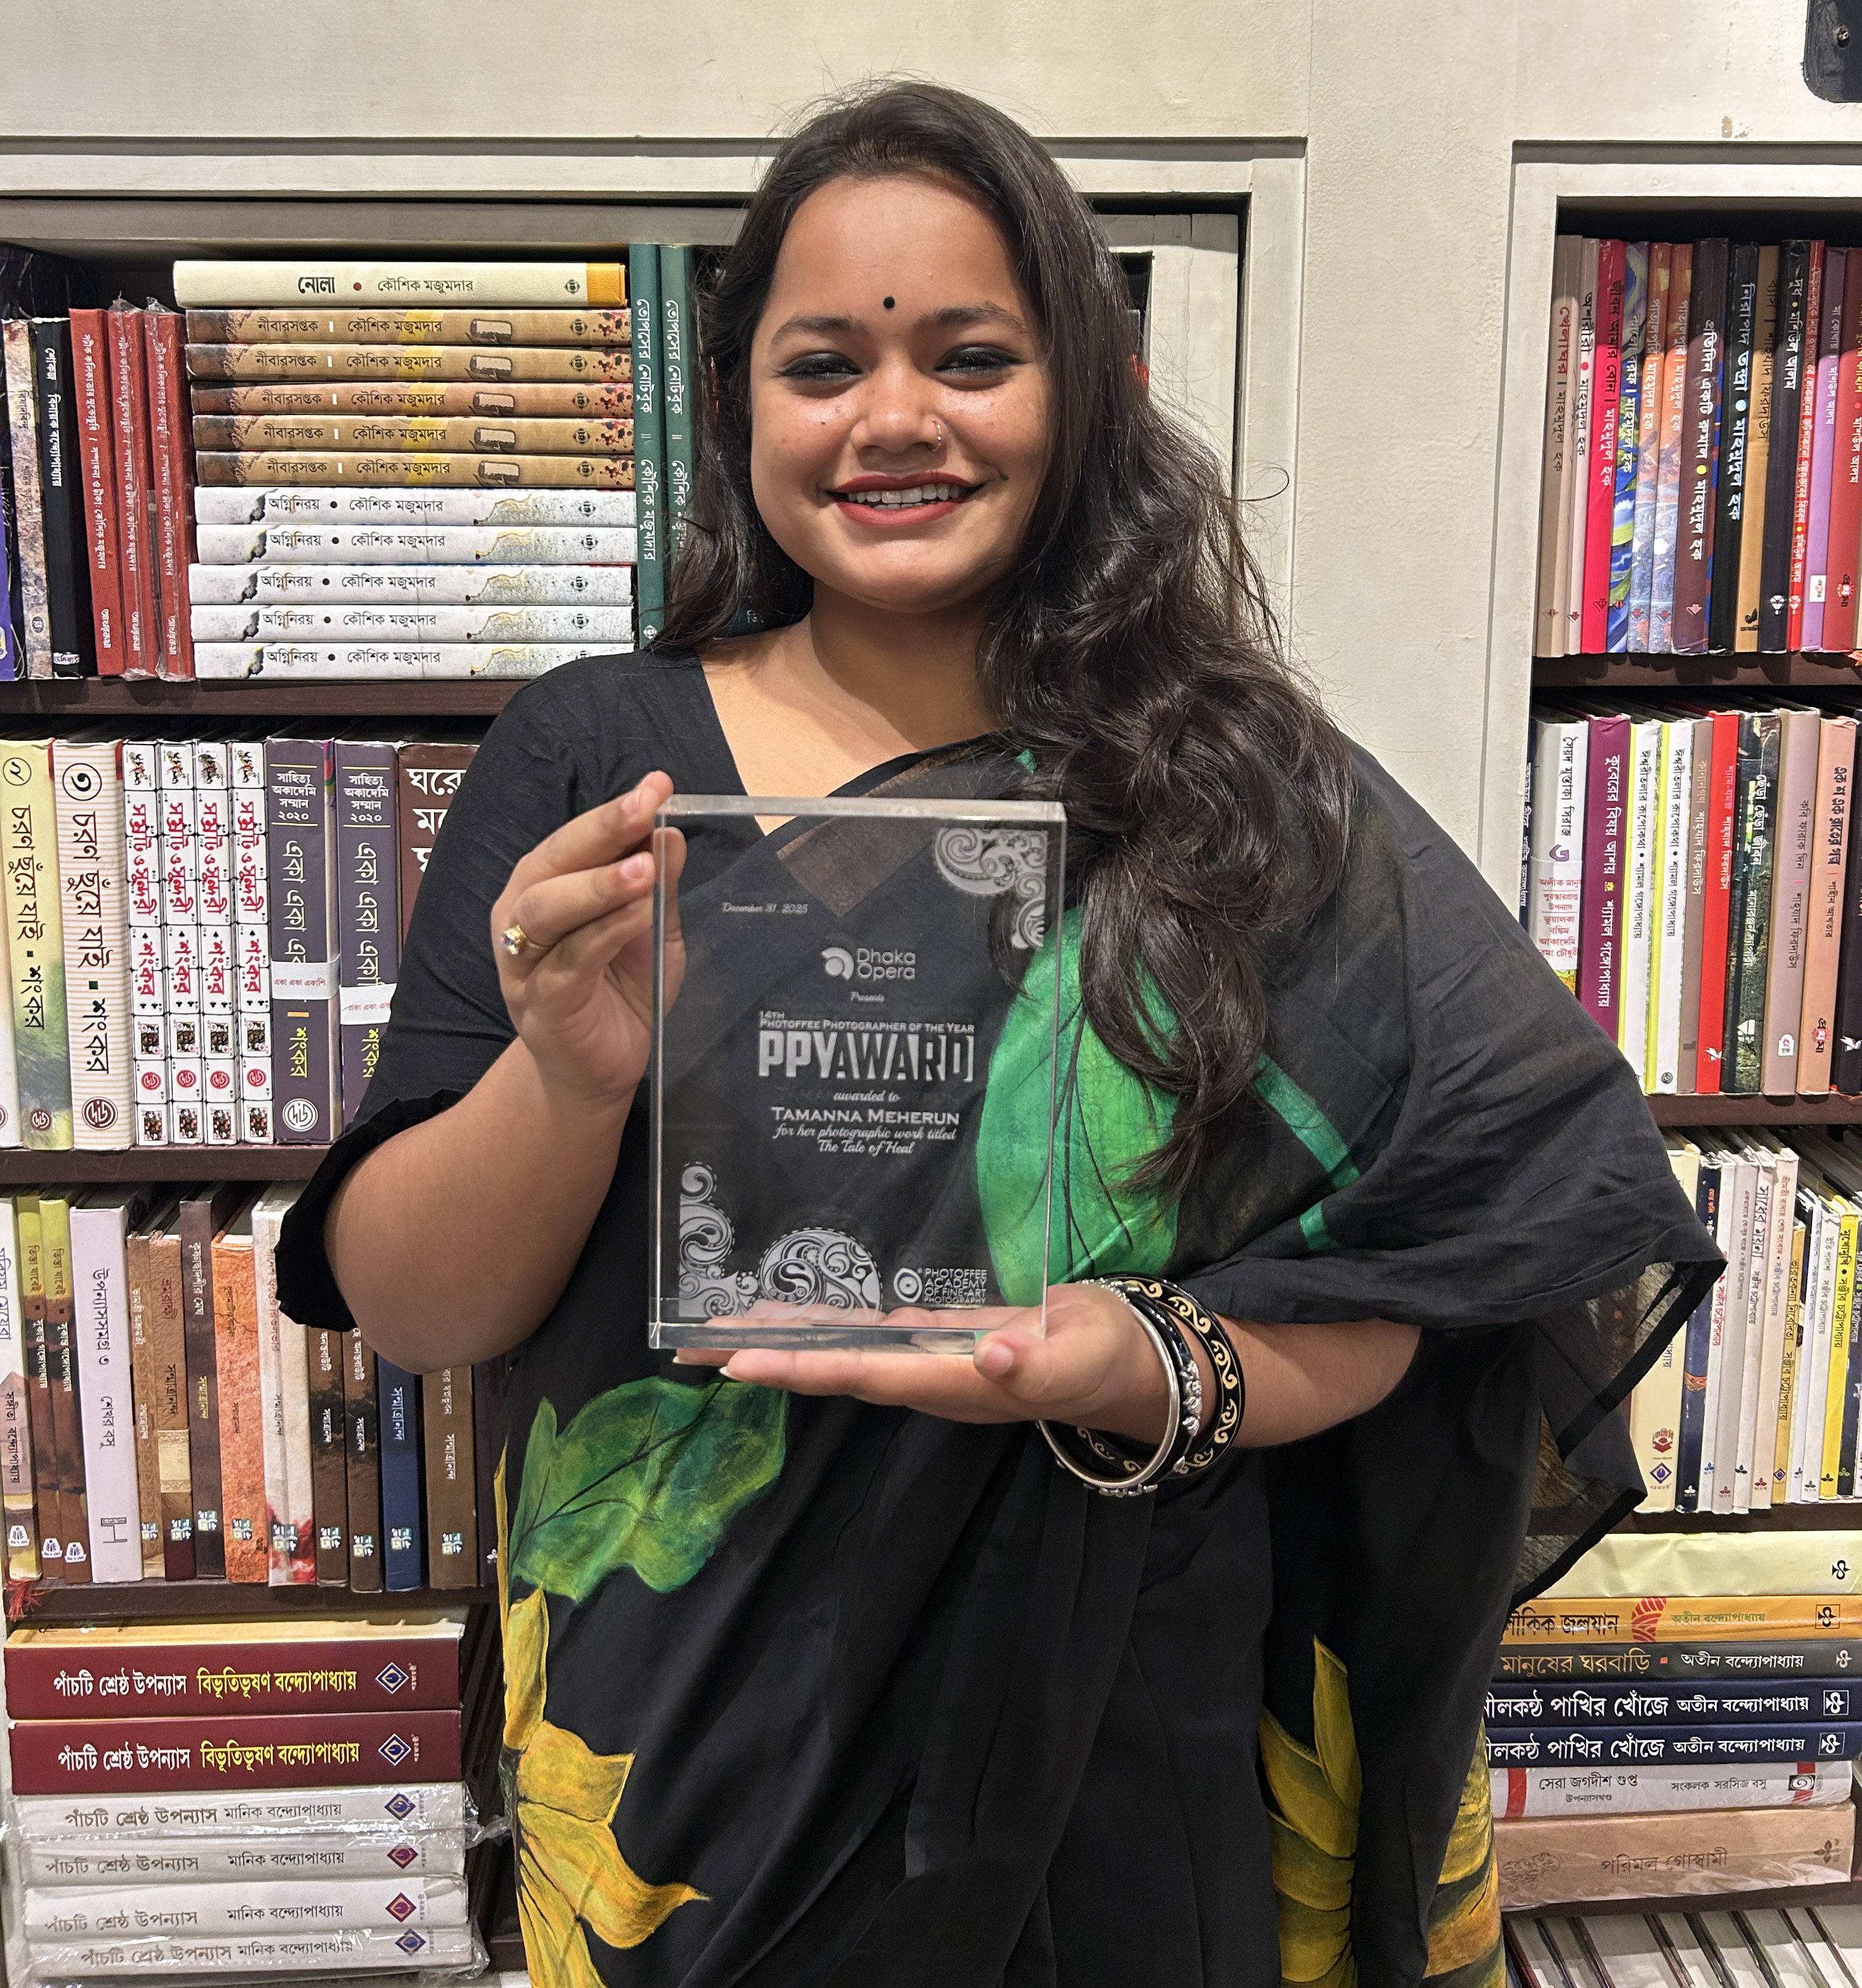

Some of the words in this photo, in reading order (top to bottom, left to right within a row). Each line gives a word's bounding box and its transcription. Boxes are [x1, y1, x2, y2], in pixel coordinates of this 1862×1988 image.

[298, 277, 335, 294] নোলা
[378, 278, 420, 293] কৌশিক
[424, 280, 473, 294] মজুমদার
[1789, 279, 1804, 297] দুধ
[258, 320, 318, 334] নীবারসপ্তক
[348, 318, 390, 333] কৌশিক
[394, 320, 442, 334] মজুমদার
[637, 299, 651, 359] তোপসের
[1738, 283, 1754, 344] নিরাপদ
[1557, 305, 1570, 374] খেলাঘর
[1700, 320, 1715, 372] প্রতিদিন
[1786, 311, 1800, 351] মশিউল
[1732, 351, 1751, 391] তন্দ্রা
[1784, 357, 1798, 389] আলম
[262, 392, 321, 406] নীবারসপ্তক
[352, 391, 393, 406] কৌশিক
[397, 393, 446, 407] মজুমদার
[638, 363, 653, 413] নোটবুক
[1699, 378, 1713, 414] একটি
[47, 394, 61, 428] বিনায়ক
[1553, 392, 1566, 443] মাহমুদুল
[1554, 451, 1563, 472] হক
[1728, 418, 1747, 487] মাহমুদুল
[640, 459, 659, 506] কৌশিক
[270, 498, 320, 514] অগ্নিনিরয়
[350, 498, 391, 512] কৌশিক
[395, 499, 444, 514] মজুমদার
[1691, 479, 1707, 534] মাহমুদুল
[1728, 494, 1741, 520] হক
[642, 510, 655, 561] মজুমদার
[1692, 539, 1703, 560] হক
[261, 575, 313, 590] অগ্নিনিরয়
[342, 575, 383, 588] কৌশিক
[388, 576, 436, 591] মজুমদার
[1560, 737, 1577, 763] সৈয়দ
[278, 770, 311, 785] সাহিত্য
[1604, 754, 1620, 802] কুবেরের
[278, 810, 309, 821] ২০২০
[280, 798, 309, 809] সম্মান
[11, 806, 36, 849] চরণ
[1560, 806, 1574, 836] সিরাজ
[1605, 807, 1621, 836] বিষয়
[73, 811, 100, 863] চরণ
[133, 855, 147, 866] ও
[283, 841, 305, 883] একা
[354, 842, 380, 884] একা
[1603, 840, 1618, 874] আশয়
[9, 855, 44, 898] ছুঁয়ে
[1668, 860, 1679, 887] শ্যামল
[67, 870, 110, 918] ছুঁয়ে
[131, 867, 157, 915] সুন্দরী
[17, 902, 47, 942] যাই
[284, 890, 307, 931] একা
[356, 892, 381, 934] একা
[1600, 900, 1614, 936] শ্যামল
[78, 926, 114, 969] যাই
[856, 948, 916, 964] Dhaka
[135, 943, 154, 996] শংকর
[856, 963, 916, 982] Opera
[1597, 941, 1613, 1007] গঙ্গোপাধ্যায়
[21, 964, 47, 1029] শংকর
[850, 992, 884, 1003] Presents
[83, 998, 111, 1074] শংকর
[288, 1026, 308, 1077] শংকর
[834, 1091, 884, 1102] awarded
[889, 1093, 900, 1102] to
[771, 1107, 863, 1122] TAMANNA
[868, 1109, 959, 1125] MEHERUN
[772, 1123, 794, 1139] for
[797, 1125, 815, 1136] her
[817, 1126, 890, 1139] photographic
[895, 1127, 924, 1139] work
[927, 1128, 956, 1139] titled
[818, 1139, 839, 1152] The
[842, 1140, 864, 1153] Tale
[869, 1141, 884, 1157] of
[885, 1141, 916, 1154] Heal
[1755, 1186, 1770, 1222] সাধের
[1751, 1228, 1766, 1259] ময়না
[925, 1268, 987, 1279] PHOTOFFEE
[925, 1278, 986, 1288] ACADEMY
[925, 1287, 939, 1296] OF
[943, 1288, 986, 1296] FINE-ART
[1834, 1304, 1846, 1348] চট্টোপাধ্যায়
[100, 1396, 115, 1426] শেখর
[100, 1431, 116, 1450] বসু
[1501, 1653, 1573, 1678] মানুষের
[1580, 1648, 1651, 1676] ঘরবাড়ি
[1681, 1651, 1720, 1668] অতীন
[1726, 1653, 1804, 1669] বন্দ্যোপাধ্যায়
[54, 1670, 94, 1696] পাঁচটি
[99, 1672, 129, 1696] শ্রেষ্ঠ
[133, 1670, 186, 1695] উপন্যাস
[196, 1667, 270, 1697] বিভূতিভূষণ
[275, 1668, 357, 1693] বন্দ্যোপাধ্যায়
[1550, 1691, 1606, 1717] পাখির
[1614, 1690, 1669, 1716] খোঁজে
[1677, 1695, 1717, 1713] অতীন
[1723, 1695, 1808, 1713] বন্দ্যোপাধ্যায়
[58, 1744, 97, 1771] পাঁচটি
[103, 1747, 133, 1771] শ্রেষ্ঠ
[137, 1745, 190, 1769] উপন্যাস
[200, 1742, 274, 1772] বিভূতিভূষণ
[278, 1742, 360, 1767] বন্দ্যোপাধ্যায়
[1539, 1776, 1566, 1789] সেরা
[1571, 1772, 1611, 1788] জগদীশ
[1617, 1773, 1638, 1787] গুপ্ত
[65, 1810, 109, 1828] পাঁচটি
[155, 1808, 217, 1824] উপন্যাস
[225, 1804, 263, 1819] মানিক
[267, 1802, 341, 1818] বন্দ্যোপাধ্যায়
[1601, 1854, 1658, 1875] পরিমল
